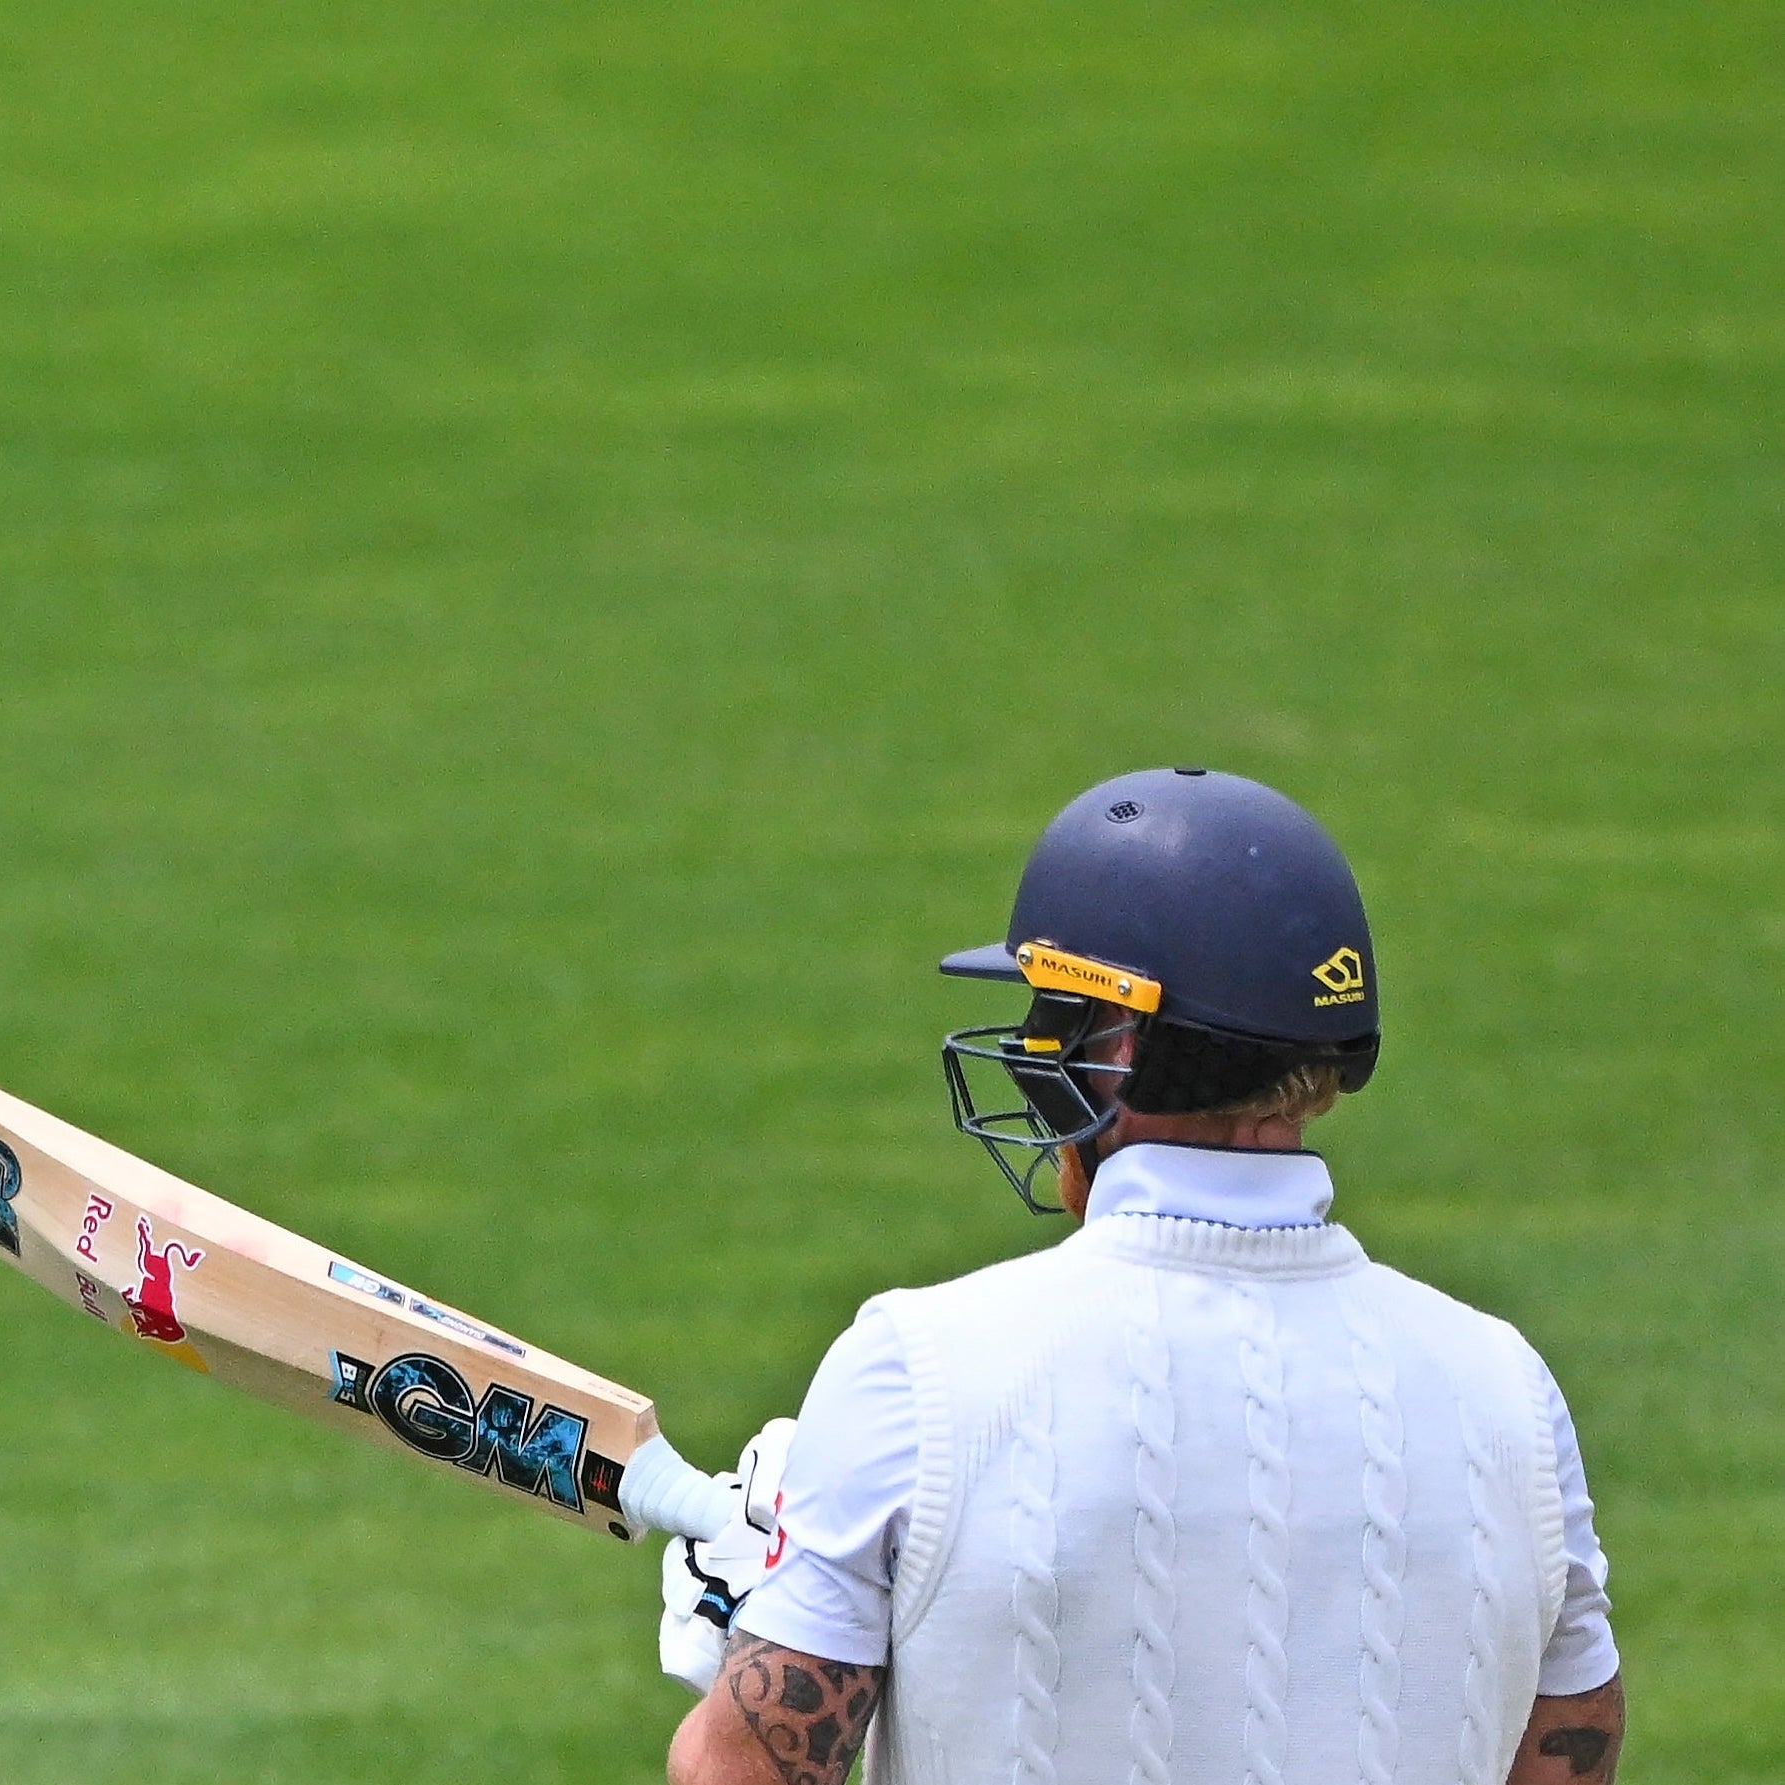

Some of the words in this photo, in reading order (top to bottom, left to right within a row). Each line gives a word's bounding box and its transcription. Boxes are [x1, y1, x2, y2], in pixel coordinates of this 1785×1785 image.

[1041, 957, 1112, 988] MASURI
[1313, 991, 1366, 1008] MASURI
[76, 1192, 114, 1264] Red
[75, 1271, 109, 1323] Bull
[369, 1352, 590, 1515] GM
